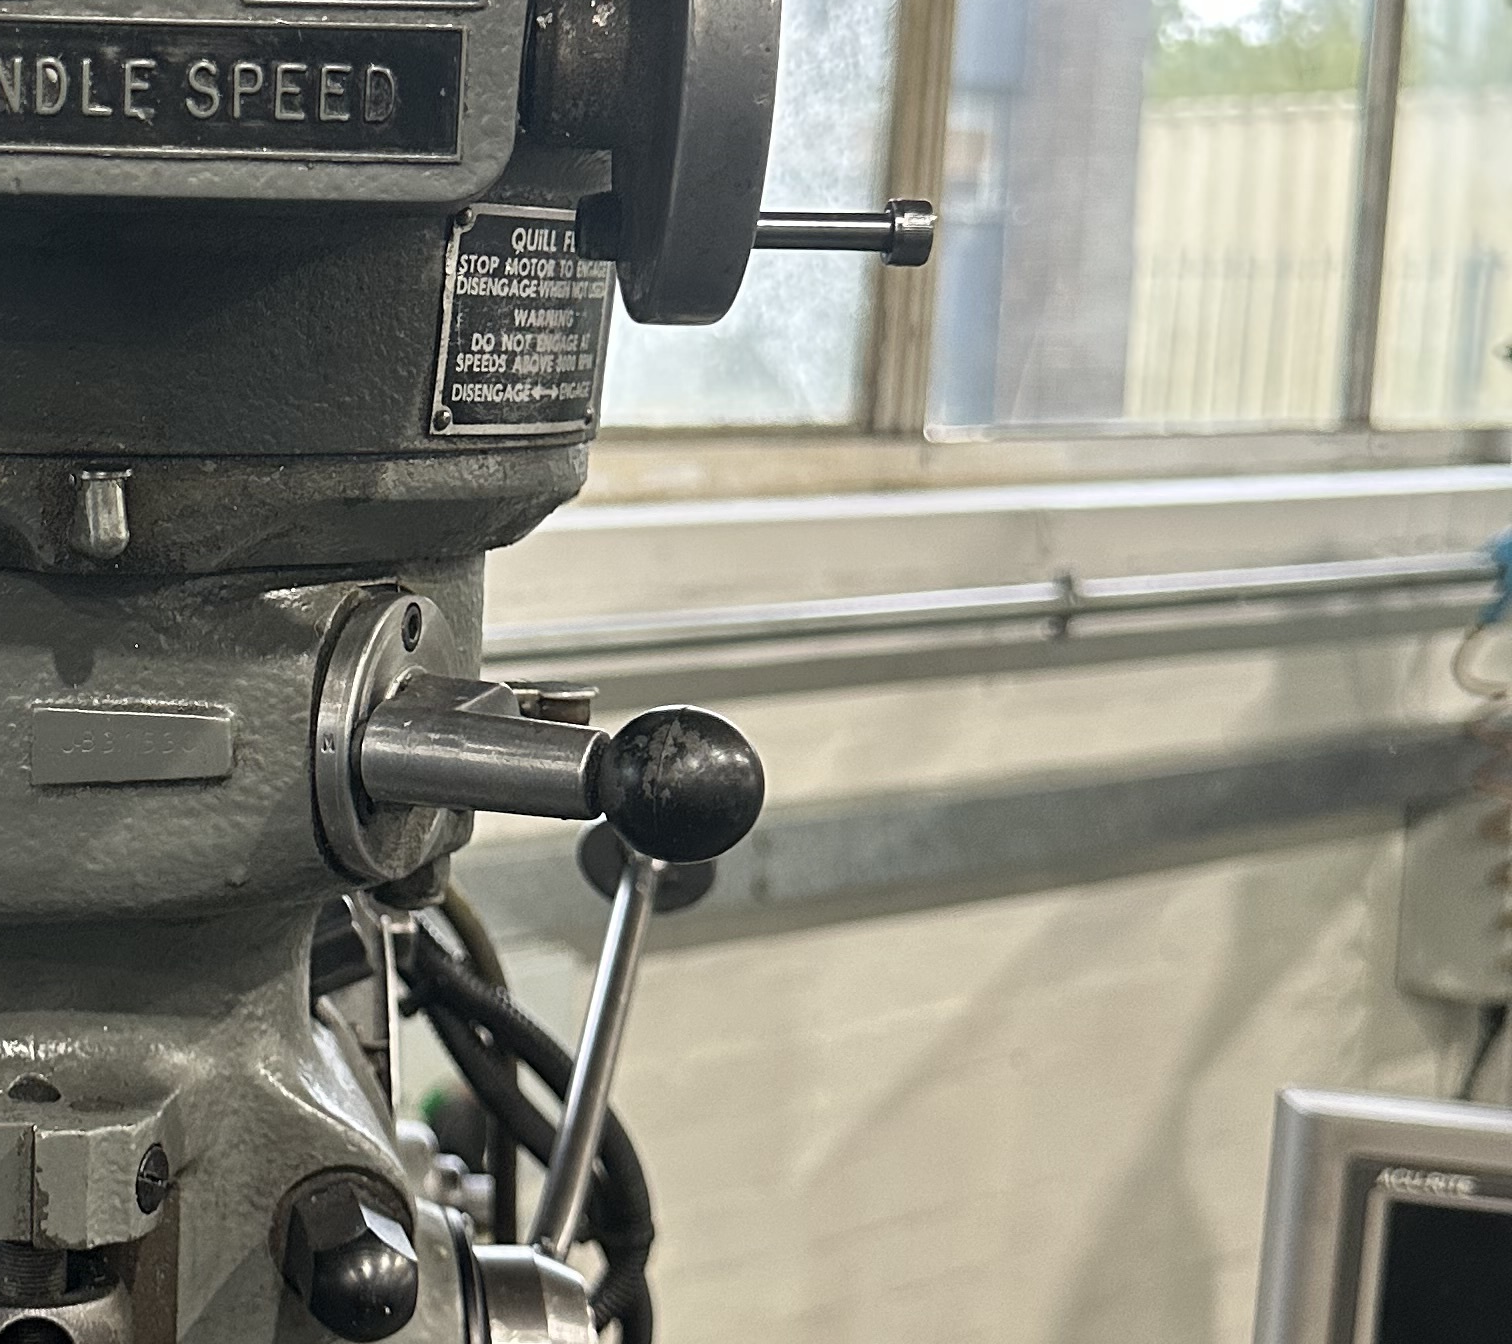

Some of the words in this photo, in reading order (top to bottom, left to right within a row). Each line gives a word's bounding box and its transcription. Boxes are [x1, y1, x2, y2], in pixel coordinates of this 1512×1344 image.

[184, 58, 397, 125] SPEED
[511, 227, 557, 255] QUILL
[458, 253, 500, 275] STOP
[504, 256, 556, 279] MOTOR
[559, 258, 574, 279] TO
[455, 275, 538, 298] DISENGAGE
[513, 307, 574, 327] WARNING
[471, 332, 496, 352] DO
[501, 332, 534, 353] NOT
[455, 352, 508, 373] SPEEDS
[511, 354, 555, 374] ABOVE
[451, 382, 531, 403] DISENGAGE
